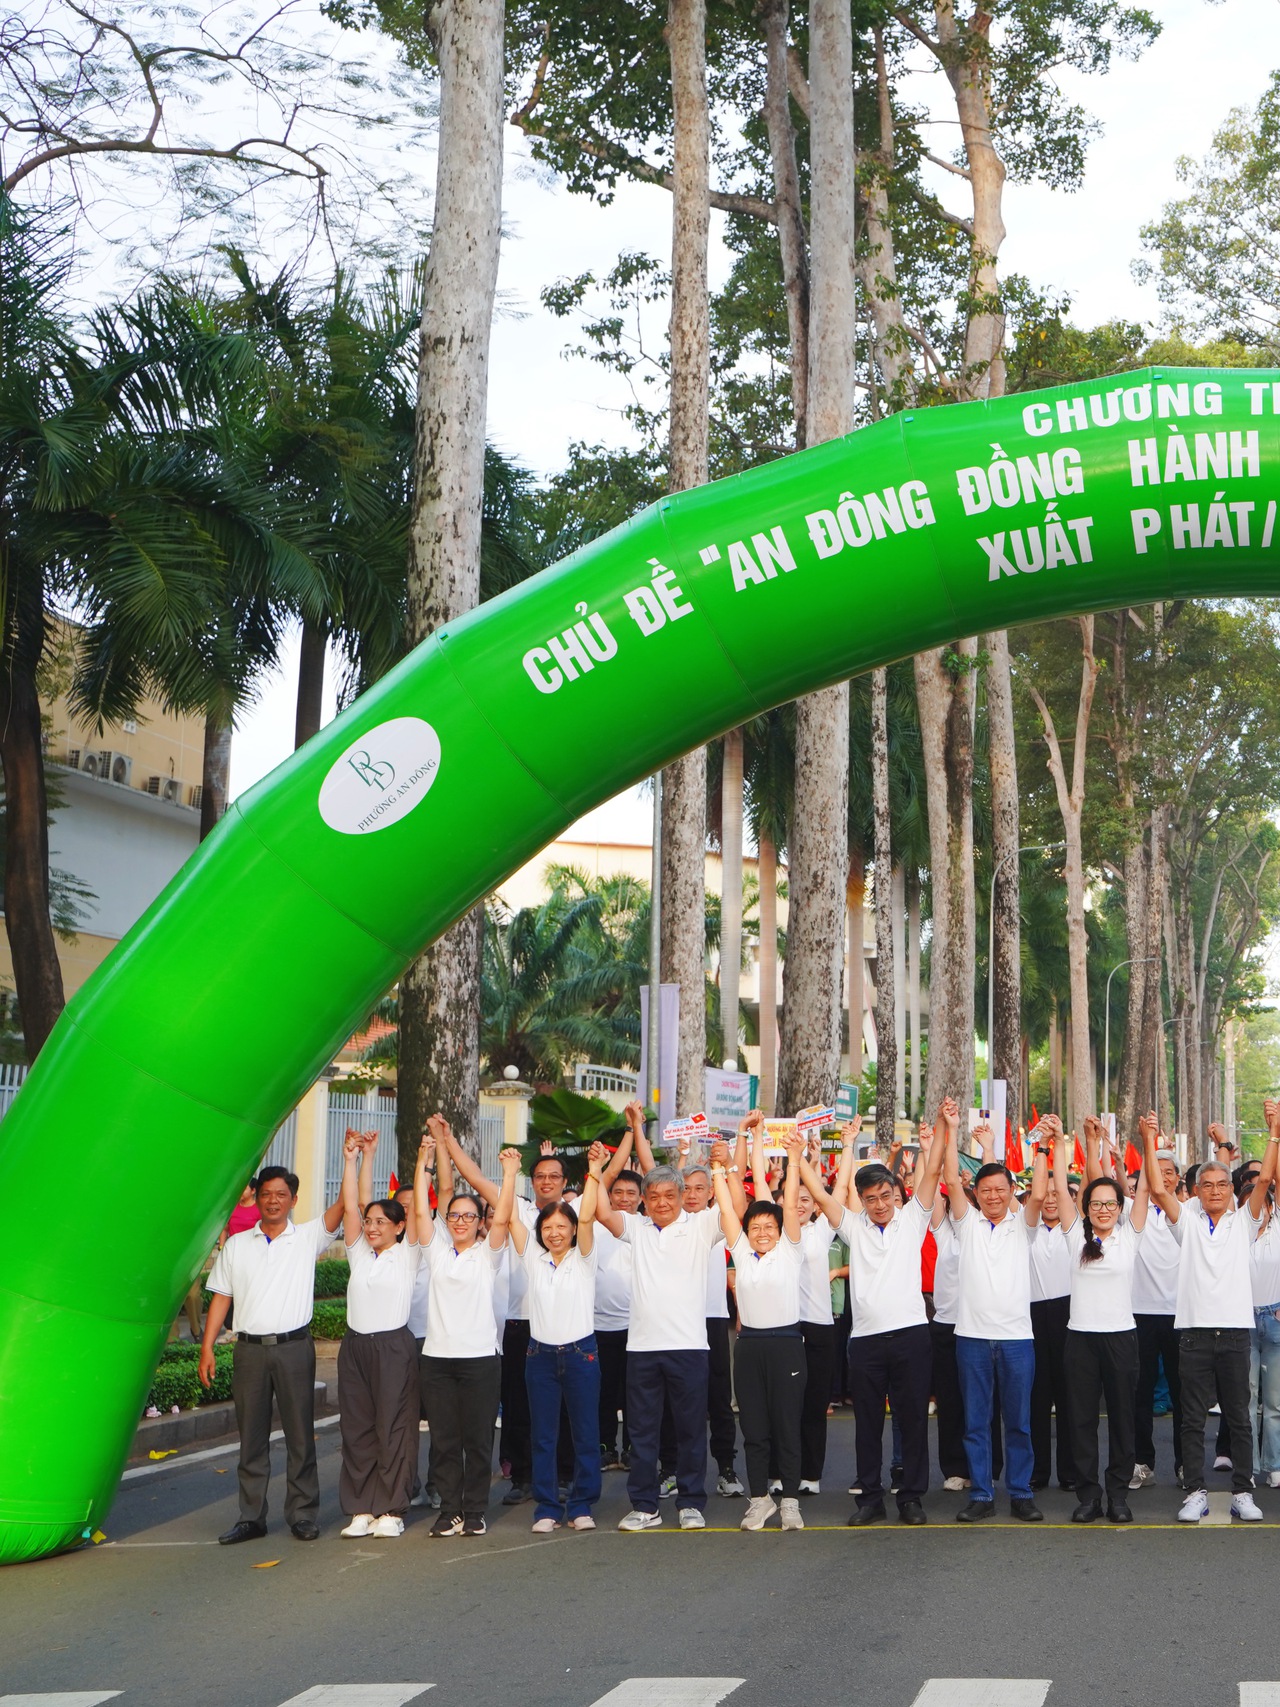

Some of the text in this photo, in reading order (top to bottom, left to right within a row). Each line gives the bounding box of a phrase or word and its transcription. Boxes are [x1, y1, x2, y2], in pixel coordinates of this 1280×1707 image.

[1023, 382, 1223, 437] CHƯƠNG
[522, 601, 618, 694] CHỦ
[624, 557, 695, 637] ĐỀ
[804, 480, 937, 560] ĐÔNG
[956, 442, 1085, 516] ĐỒNG
[1127, 424, 1260, 487] HÀNH
[976, 502, 1094, 582] XUẤT
[357, 758, 437, 831] PHƯỜNG AN ĐÔNG
